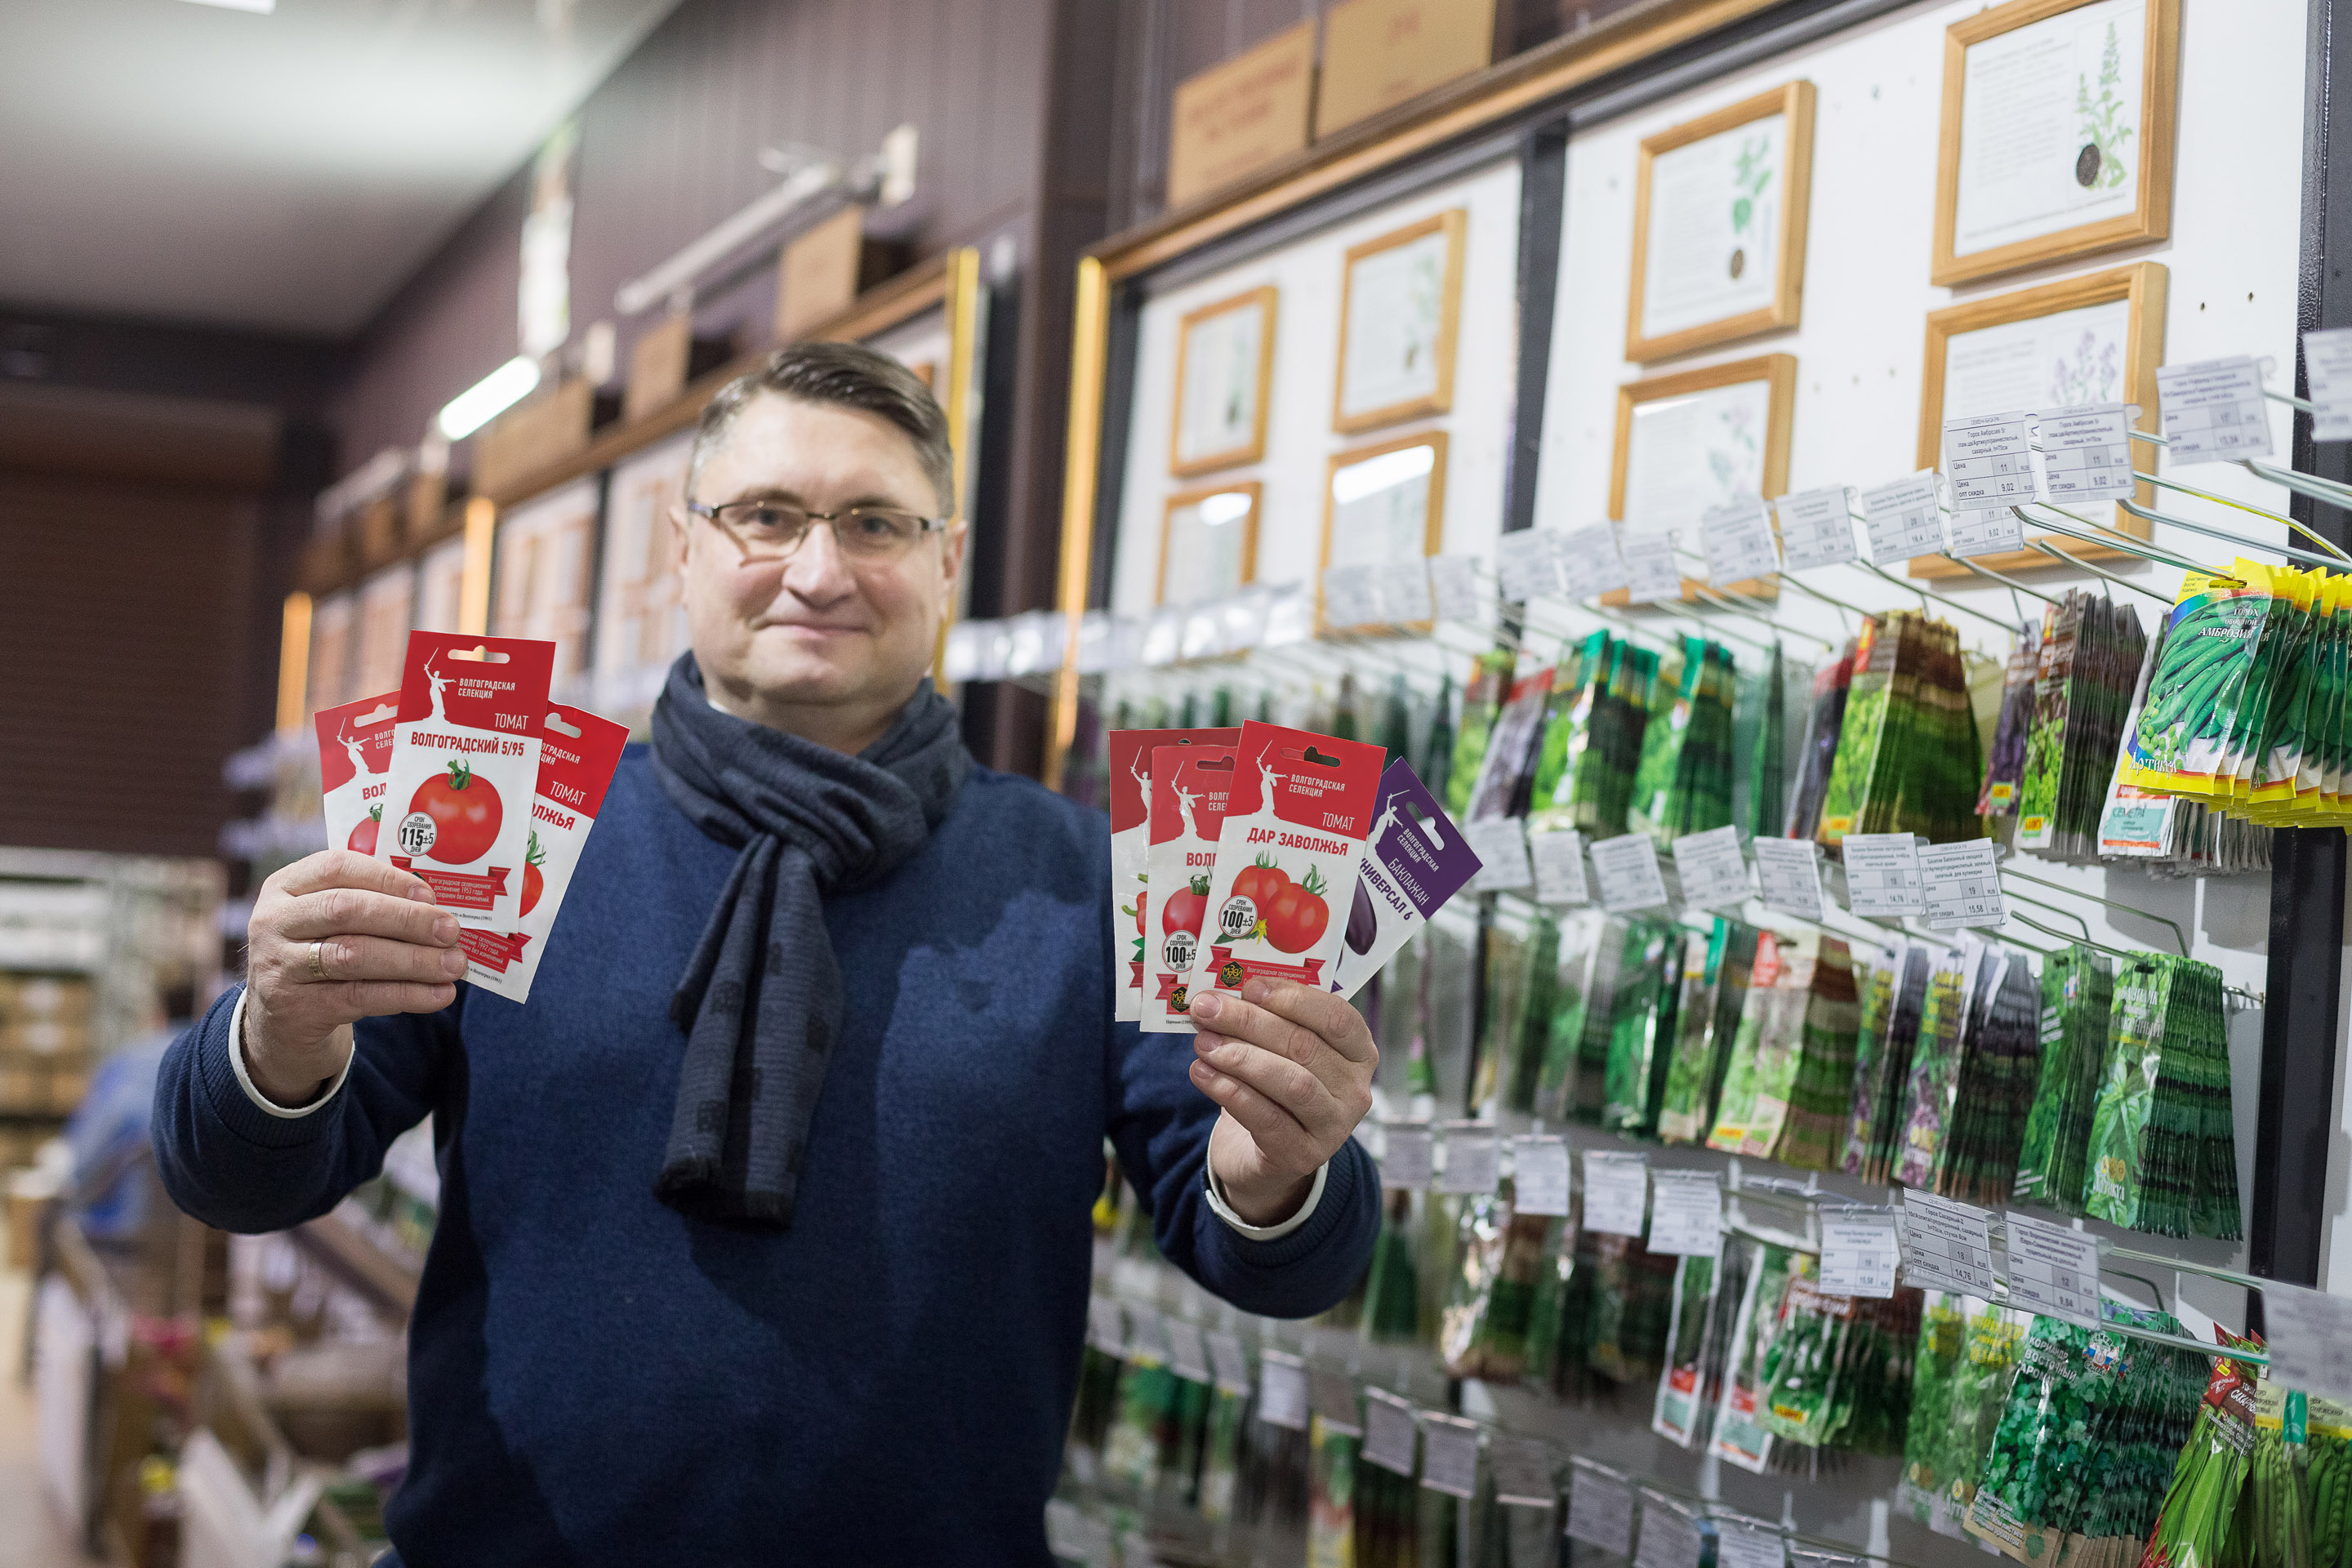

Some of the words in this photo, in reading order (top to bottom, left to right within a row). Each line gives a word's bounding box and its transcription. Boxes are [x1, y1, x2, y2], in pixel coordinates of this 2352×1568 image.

[2000, 464, 2008, 472] 11
[2002, 483, 2014, 492] 9,02
[2234, 608, 2260, 617] ГОРОХ
[2198, 627, 2253, 639] АМБРОЗИЯ
[460, 678, 515, 691] ВОЛГОГРАДСКАЯ
[458, 688, 492, 699] СЕЛЕКЦИЯ
[495, 713, 528, 730] ТОМАТ
[411, 732, 499, 754] ВОЛГОГРАДСКИЙ
[501, 742, 524, 756] 5/95
[542, 743, 581, 764] ОГРАДСКАЯ
[1291, 774, 1345, 791] ВОЛГОГРАДСКАЯ
[550, 781, 586, 805] ТОМАТ
[1289, 784, 1323, 797] СЕЛЕКЦИЯ
[1322, 812, 1355, 831] ТОМАТ
[1247, 827, 1276, 844] ДАР
[1278, 832, 1348, 856] ЗАВОЛЖЬЯ
[1397, 835, 1421, 863] СЕЛЕКЦИЯ
[1403, 828, 1439, 872] ВОЛГОГРАДСКАЯ
[429, 876, 461, 886] Волгоградское
[461, 881, 491, 889] селекционное
[1388, 858, 1430, 906] БАКЛАЖАН
[1969, 887, 1976, 895] 19
[1228, 904, 1252, 912] СОЗРЕВАНИЯ
[1969, 905, 1984, 914] 15,58
[1404, 911, 1413, 920] 6
[1247, 967, 1277, 975] Волгоградское
[1926, 1209, 1937, 1217] Горох
[1910, 1230, 1922, 1239] Цена
[1958, 1251, 1964, 1259] 18
[1913, 1247, 1924, 1257] Цена
[1923, 1262, 1939, 1271] скидка
[1956, 1269, 1971, 1281] 14,76
[2062, 1277, 2069, 1287] 12
[2029, 1335, 2069, 1360] КОРИАНДР
[2025, 1349, 2077, 1382] ВОСТОЧНЫЙ
[2230, 1389, 2256, 1414] САХАРНЫ
